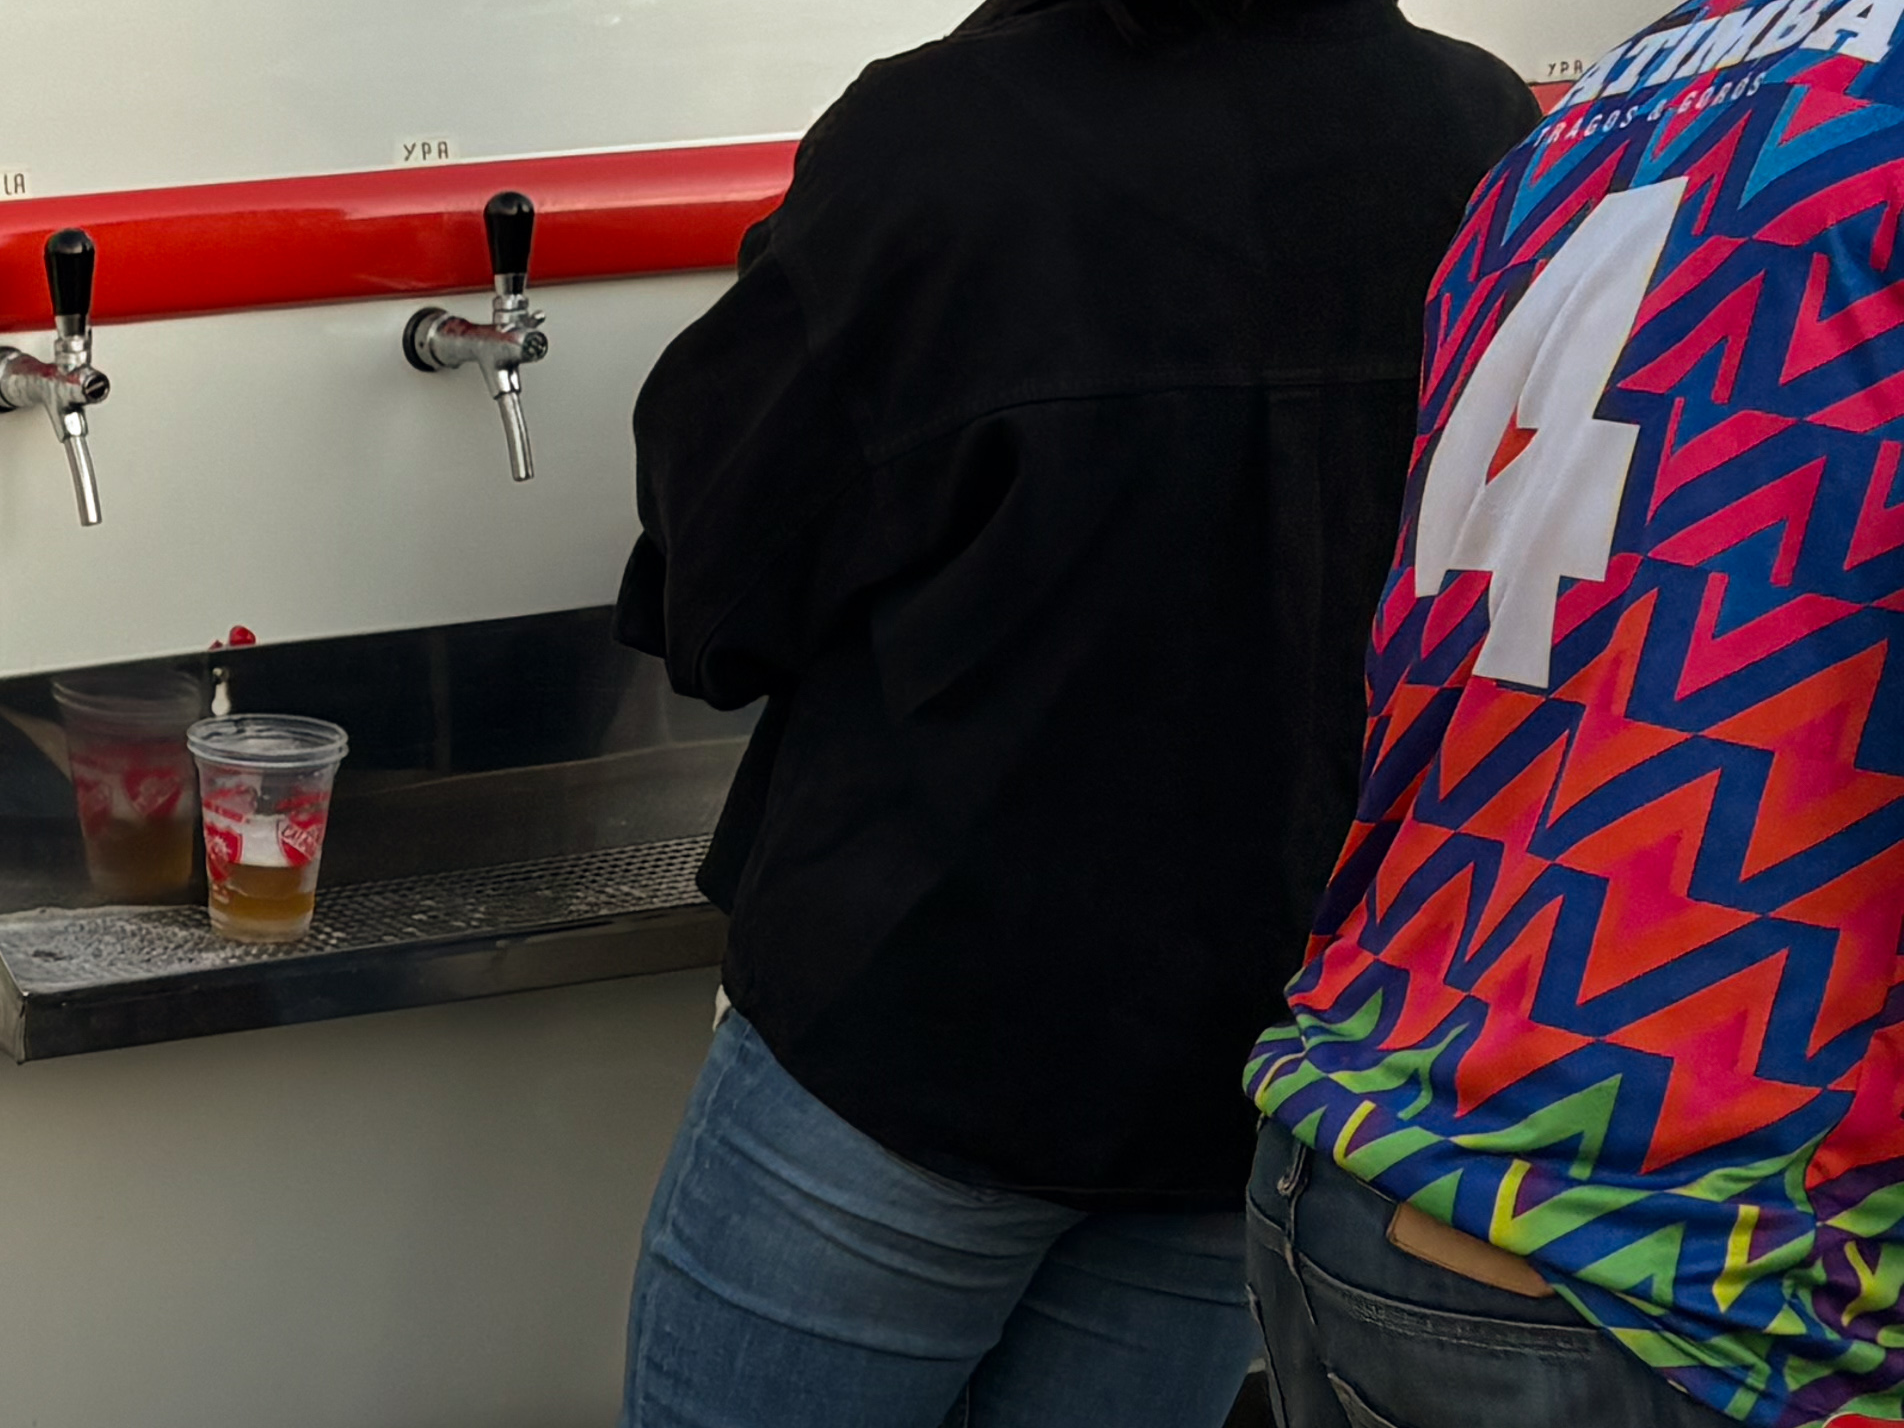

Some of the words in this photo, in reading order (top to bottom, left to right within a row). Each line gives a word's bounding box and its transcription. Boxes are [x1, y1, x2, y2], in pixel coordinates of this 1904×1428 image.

[1681, 73, 1765, 114] GORÓS
[402, 139, 454, 164] YPA
[1414, 176, 1689, 690] 4
